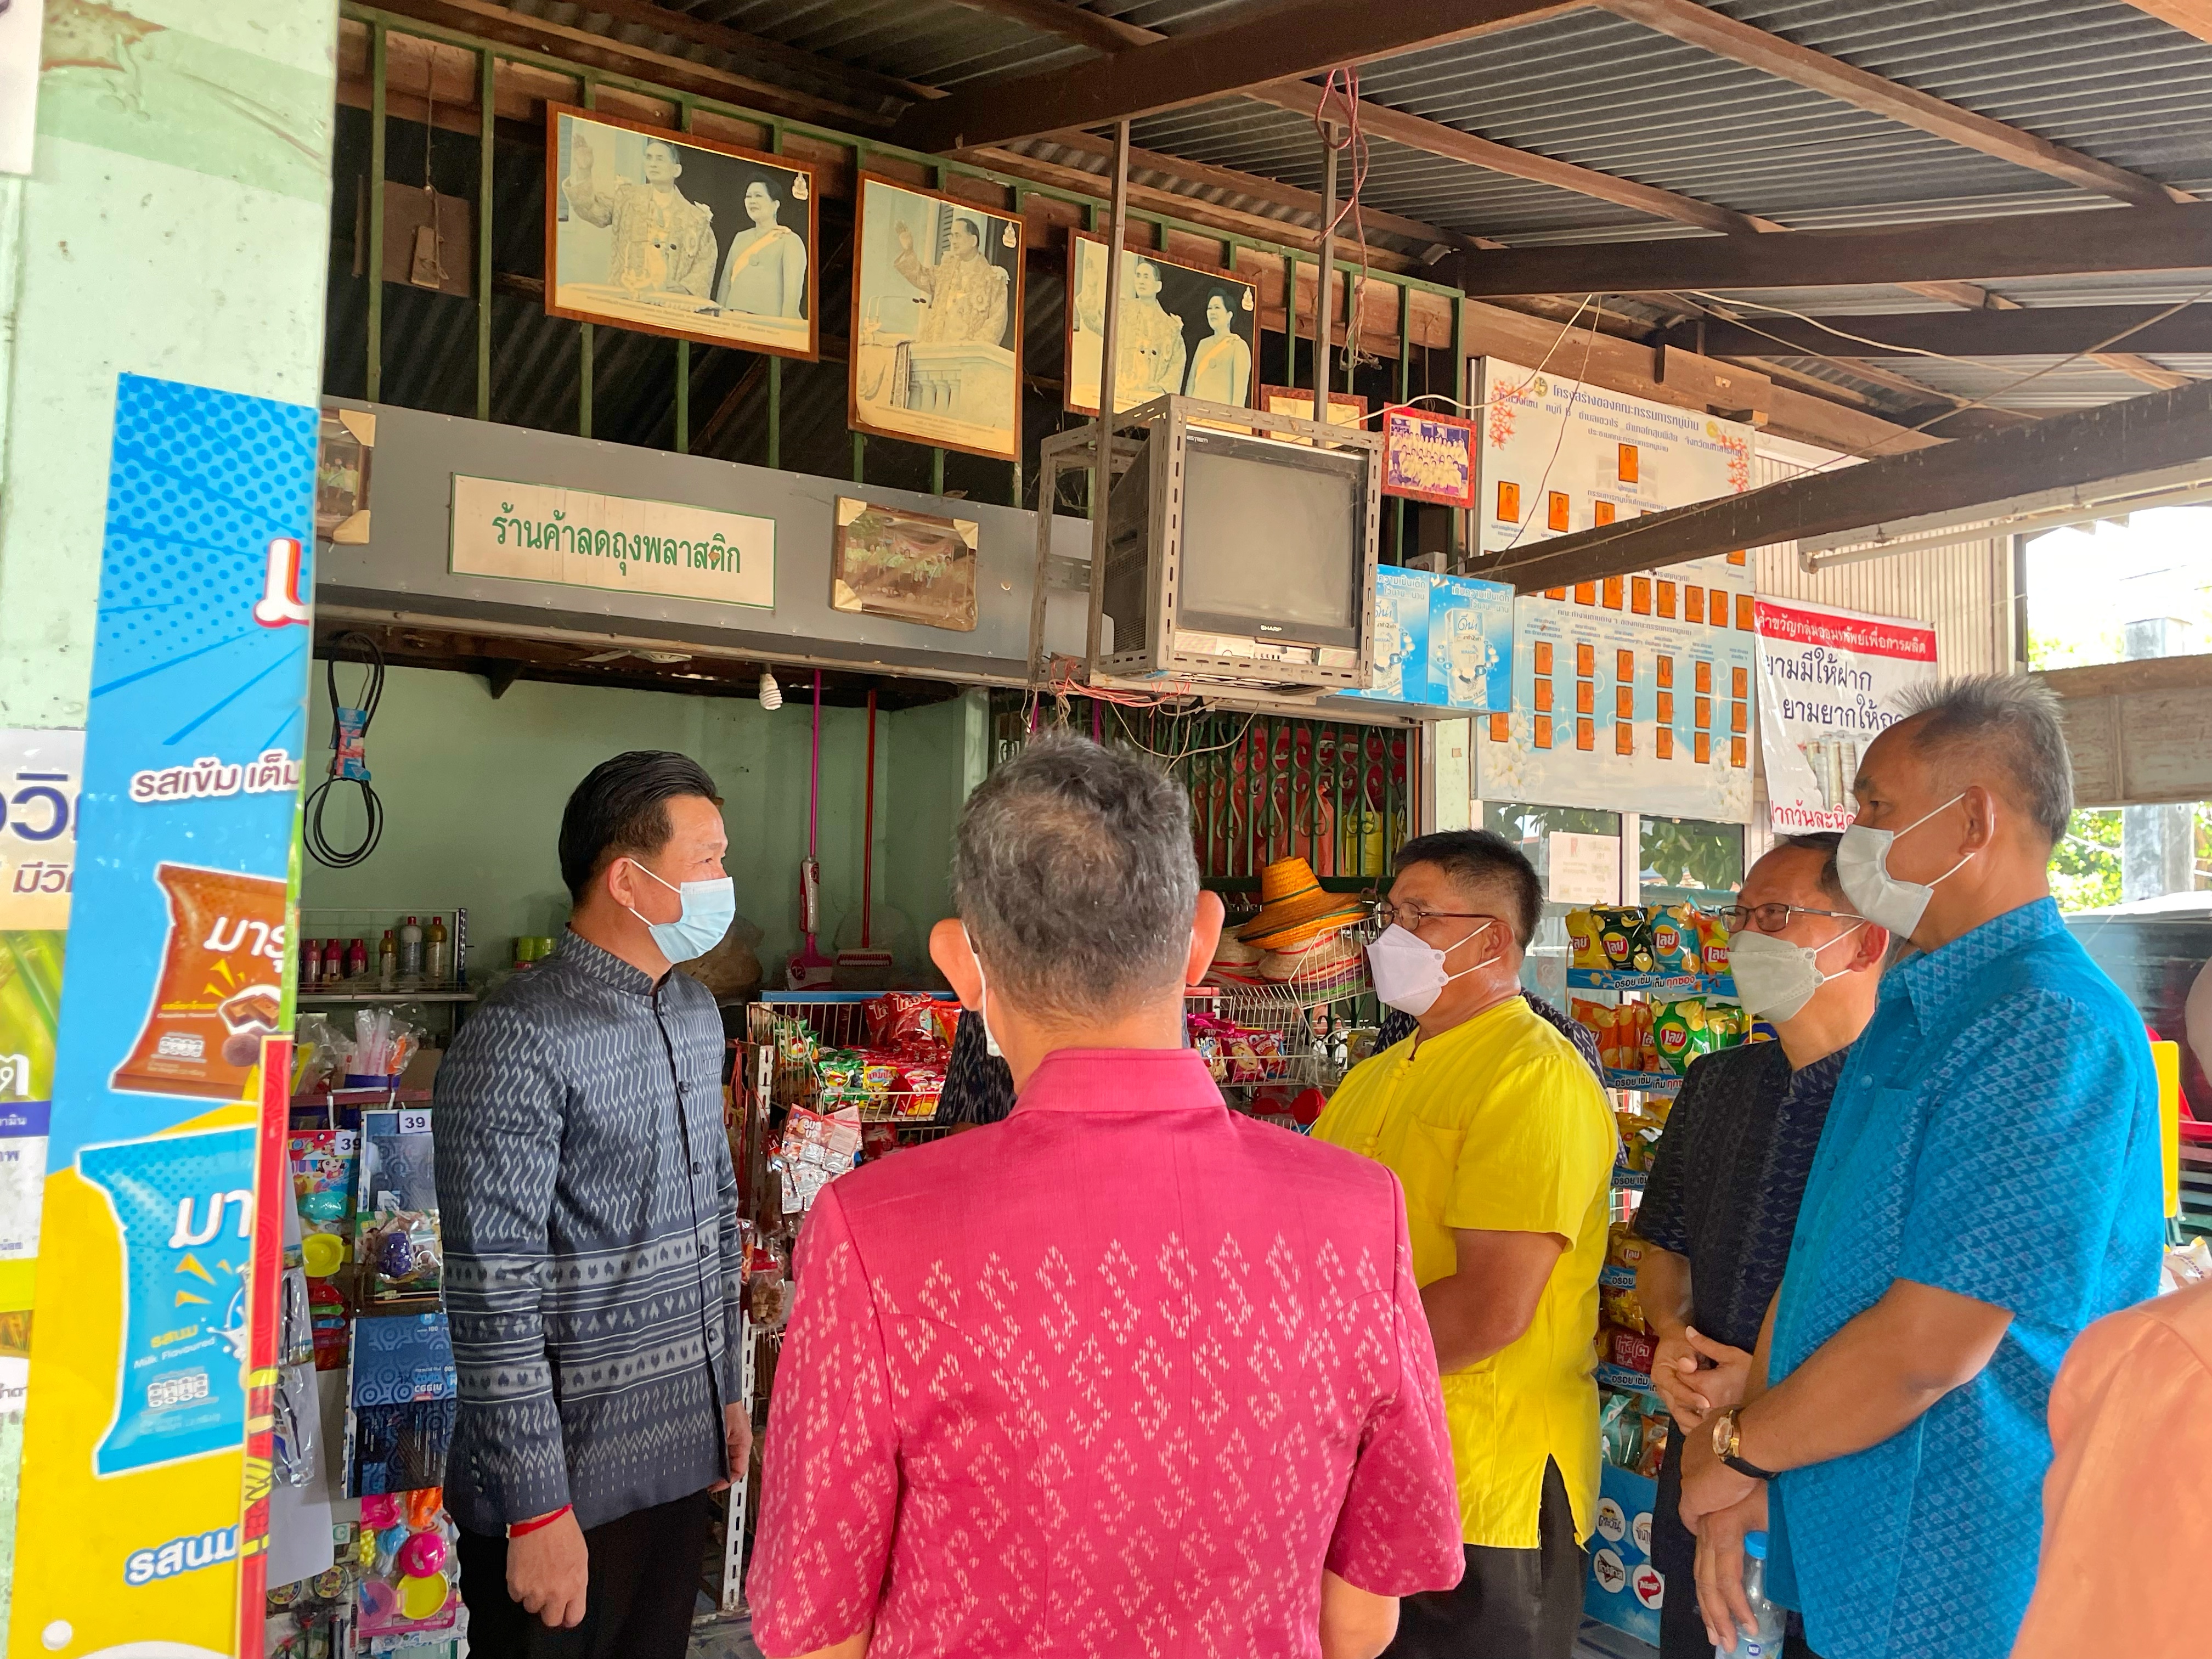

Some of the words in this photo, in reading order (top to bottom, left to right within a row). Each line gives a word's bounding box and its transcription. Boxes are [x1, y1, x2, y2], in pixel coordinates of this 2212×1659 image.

[492, 501, 741, 576] ร้านค้าลดถุงพลาสติก
[1764, 647, 1872, 691] ยามมีให้ฝาก
[134, 762, 240, 797] รสเข้ม
[1615, 977, 1636, 989] อร่อย
[1638, 974, 1651, 985] เข้ม
[1615, 1076, 1637, 1087] อร่อย
[1638, 1074, 1651, 1085] เข้ม
[404, 1116, 426, 1128] 39
[341, 1138, 361, 1150] 39
[1612, 1273, 1633, 1285] อร่อย
[1611, 1373, 1634, 1384] อร่อย
[1635, 1374, 1649, 1385] เข้ม
